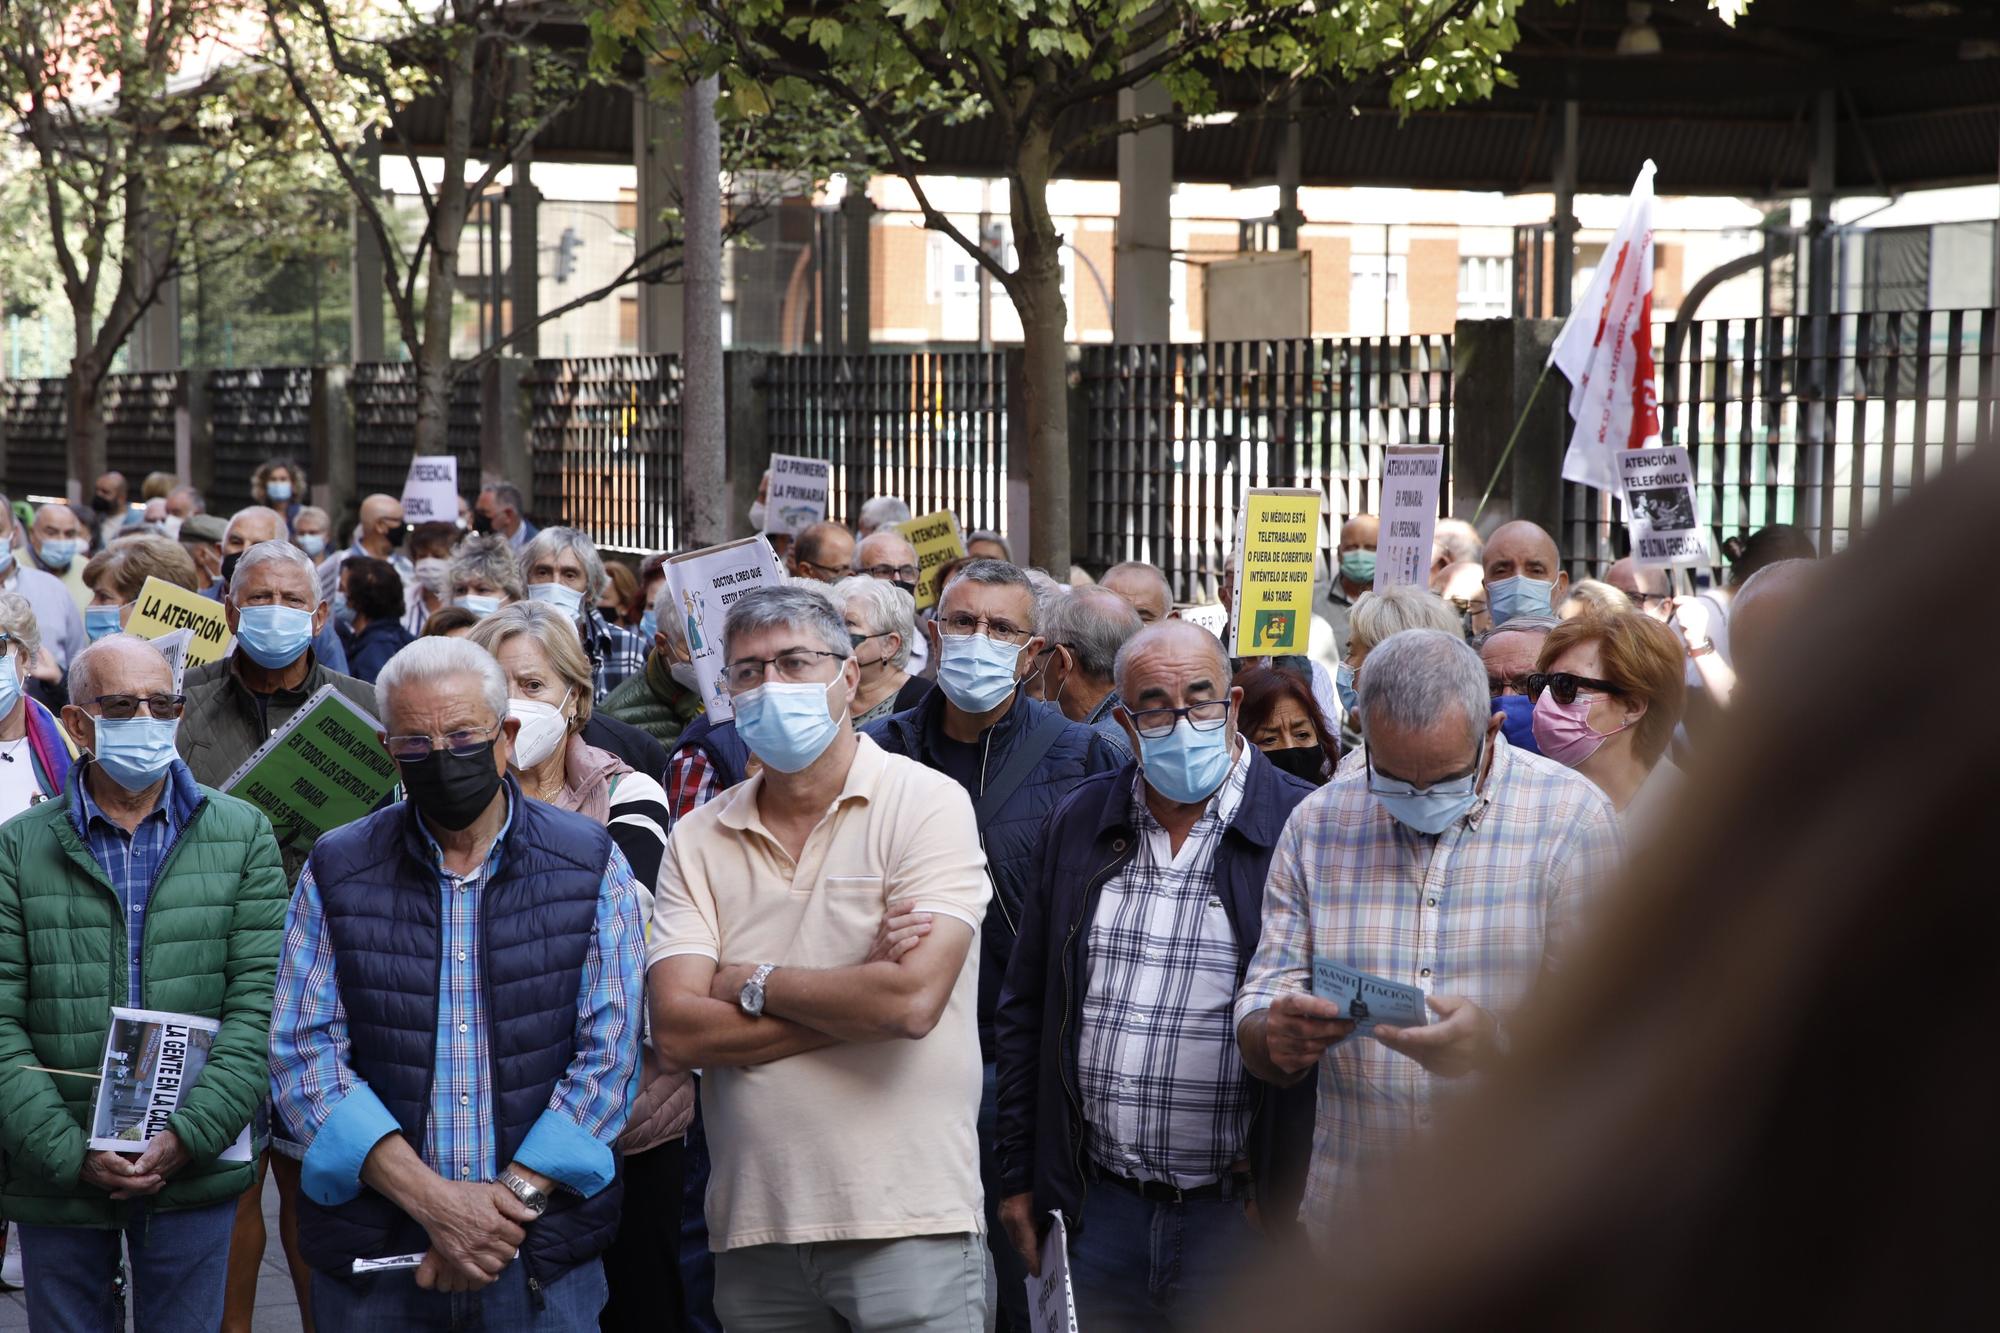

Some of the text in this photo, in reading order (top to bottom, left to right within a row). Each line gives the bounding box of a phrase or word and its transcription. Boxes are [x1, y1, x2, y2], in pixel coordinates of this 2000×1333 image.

[776, 459, 788, 472] LO
[1625, 454, 1677, 468] ATENCIÓN
[1624, 472, 1688, 487] TELEFÓNICA
[774, 484, 824, 502] LA PRIMARIA
[1261, 508, 1306, 524] SU MÉDICO ESTÁ
[911, 520, 952, 544] ATENCIÓN
[1399, 520, 1421, 538] PERSONAL
[1258, 531, 1307, 544] TELETRABAJANDO
[1248, 551, 1312, 563] O FUERA DE COBERTURA
[712, 566, 762, 589] DOCTOR, CREO QUE
[1250, 568, 1308, 582] INTÉNTELO DE NUEVO
[918, 582, 930, 596] ES
[1262, 588, 1292, 602] MÁS TARDE
[721, 591, 738, 605] ESTOY
[142, 595, 226, 644] LA ATENCIÓN
[316, 716, 396, 780] ATENCIÓN CONTINUADA
[287, 732, 380, 806] EN TODOS LOS CENTROS DE
[246, 781, 280, 811] CALIDAD
[272, 798, 289, 819] ES
[290, 776, 329, 809] PRIMARIA
[165, 1024, 188, 1038] LA
[160, 1040, 186, 1076] GENTE
[156, 1077, 180, 1092] EN
[152, 1092, 177, 1106] LA
